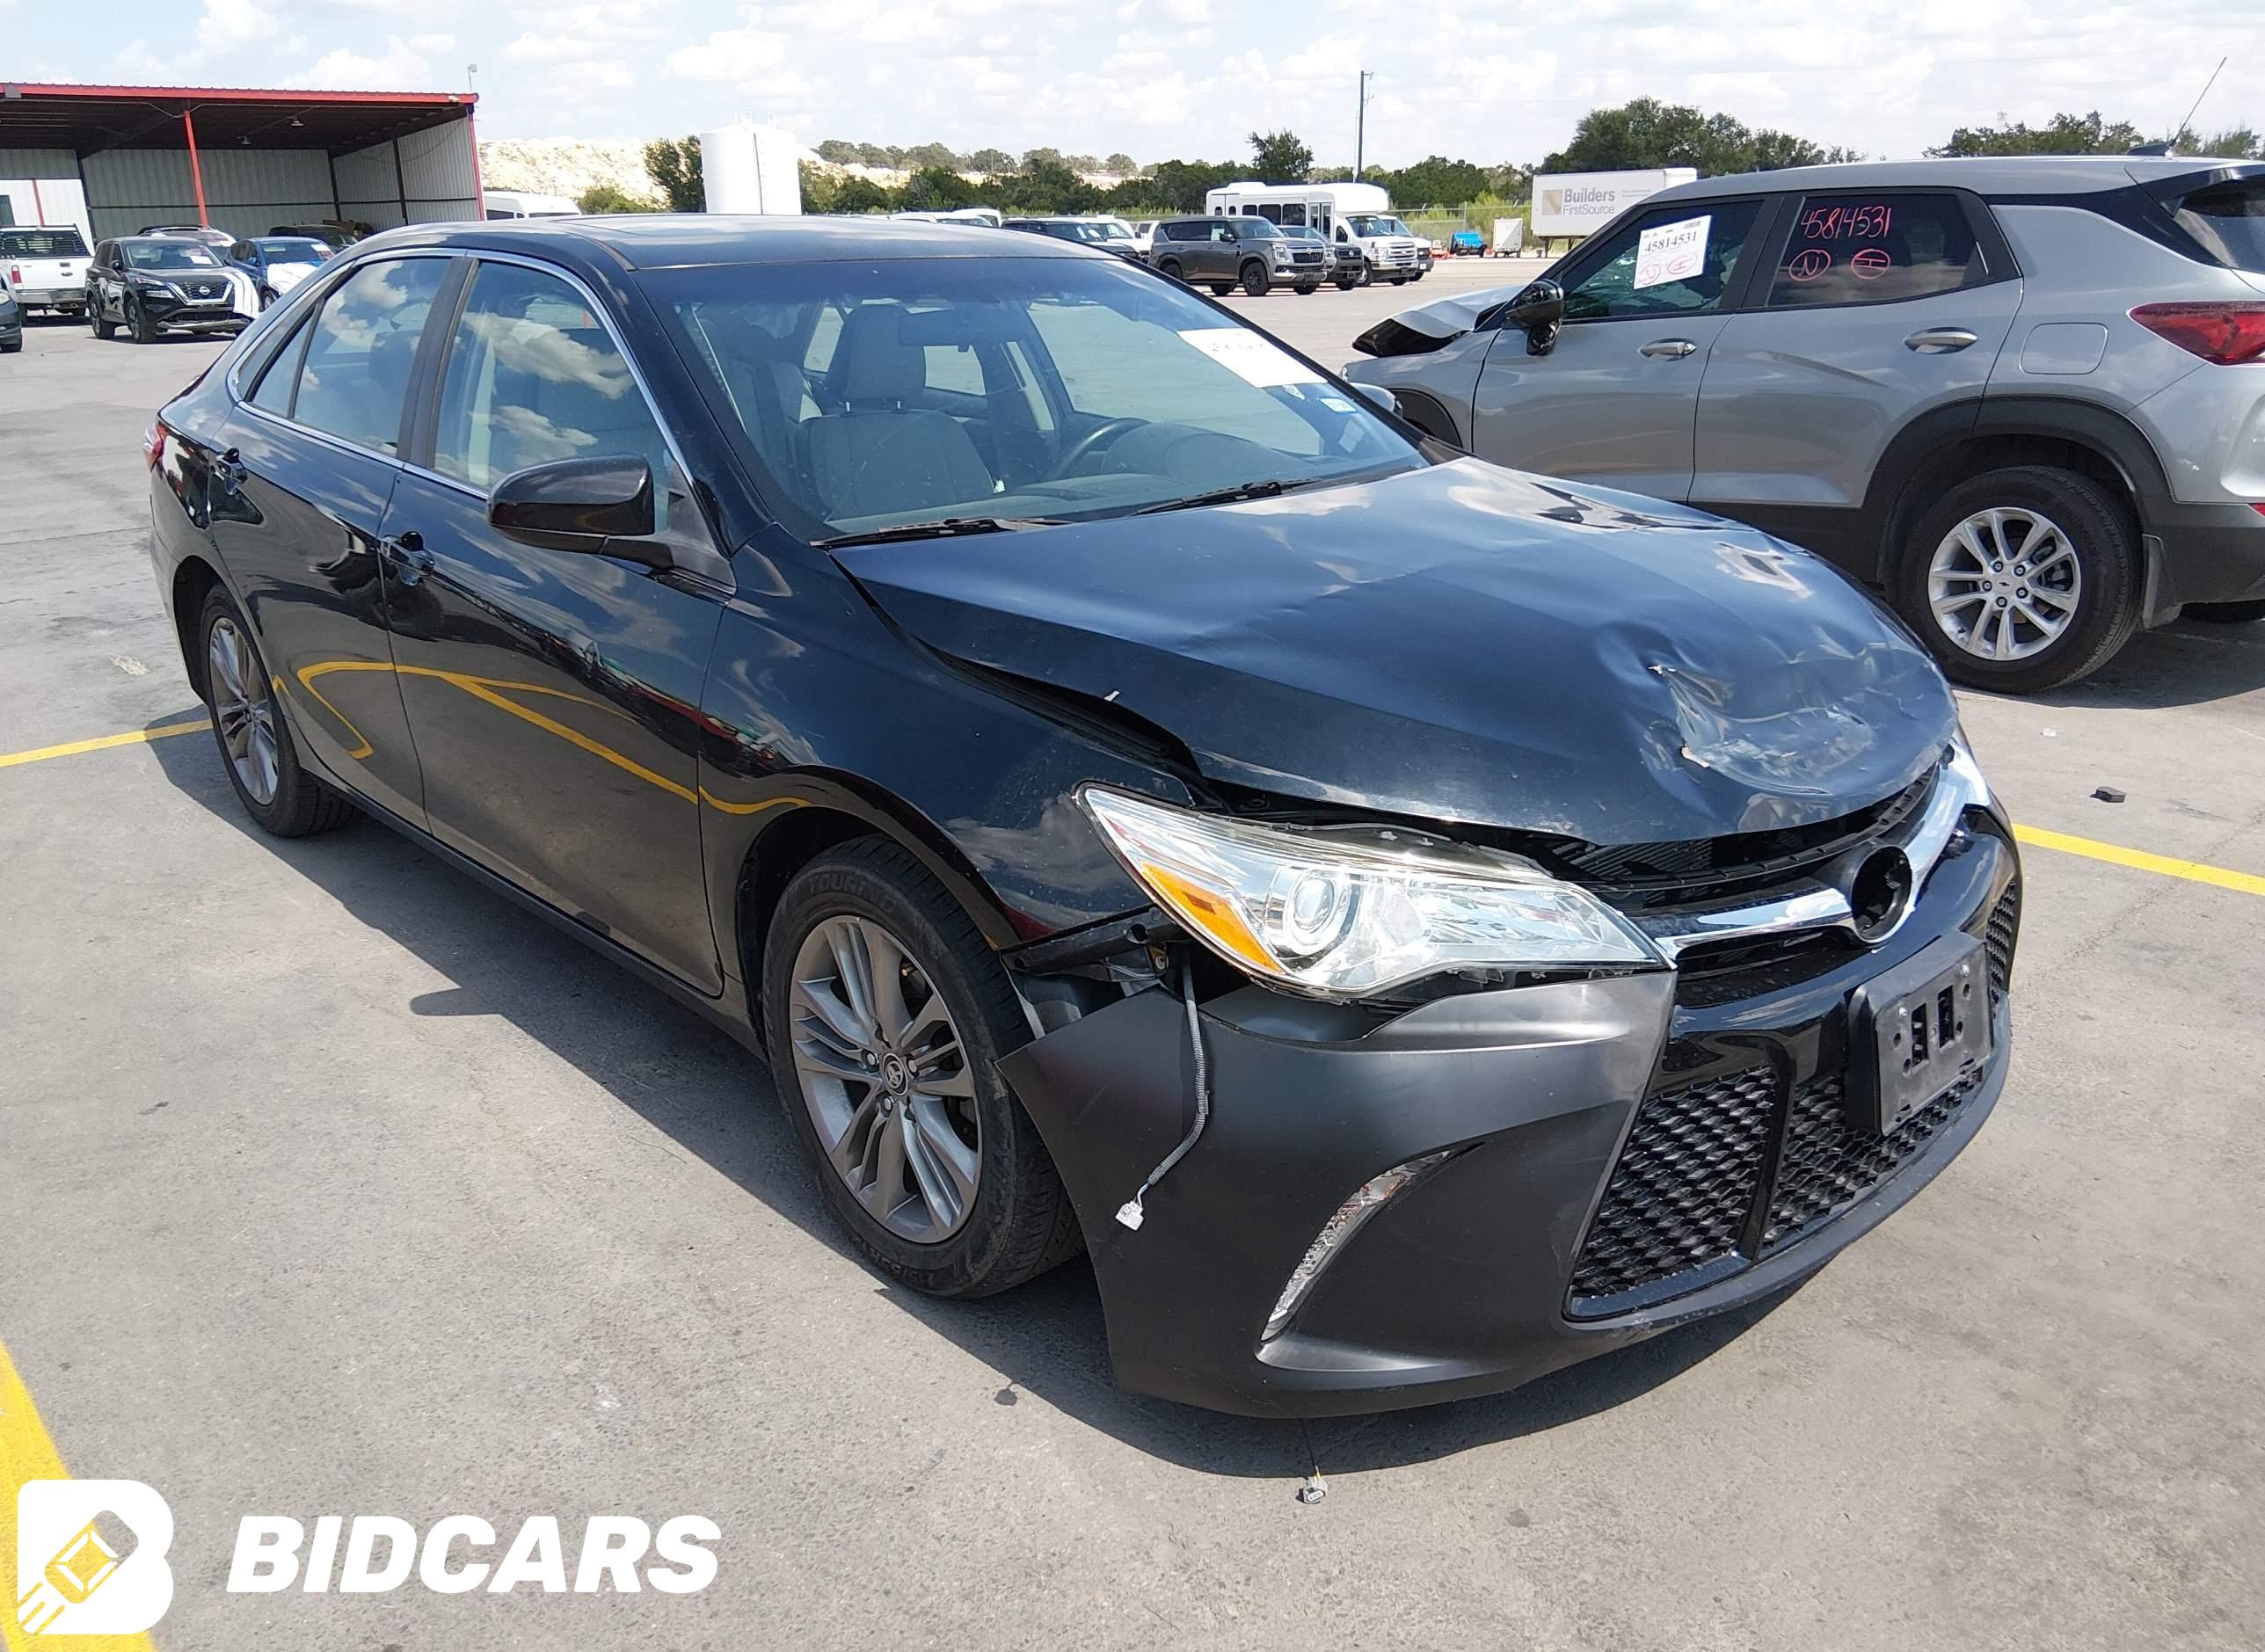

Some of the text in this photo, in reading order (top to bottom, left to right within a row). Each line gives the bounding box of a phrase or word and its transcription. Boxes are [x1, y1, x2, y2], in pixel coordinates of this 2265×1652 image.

[1564, 188, 1615, 202] Builders
[1563, 204, 1614, 215] FirstSource
[1801, 206, 1891, 239] 45814531
[1644, 231, 1697, 252] 45814531
[808, 872, 896, 913] TOURING
